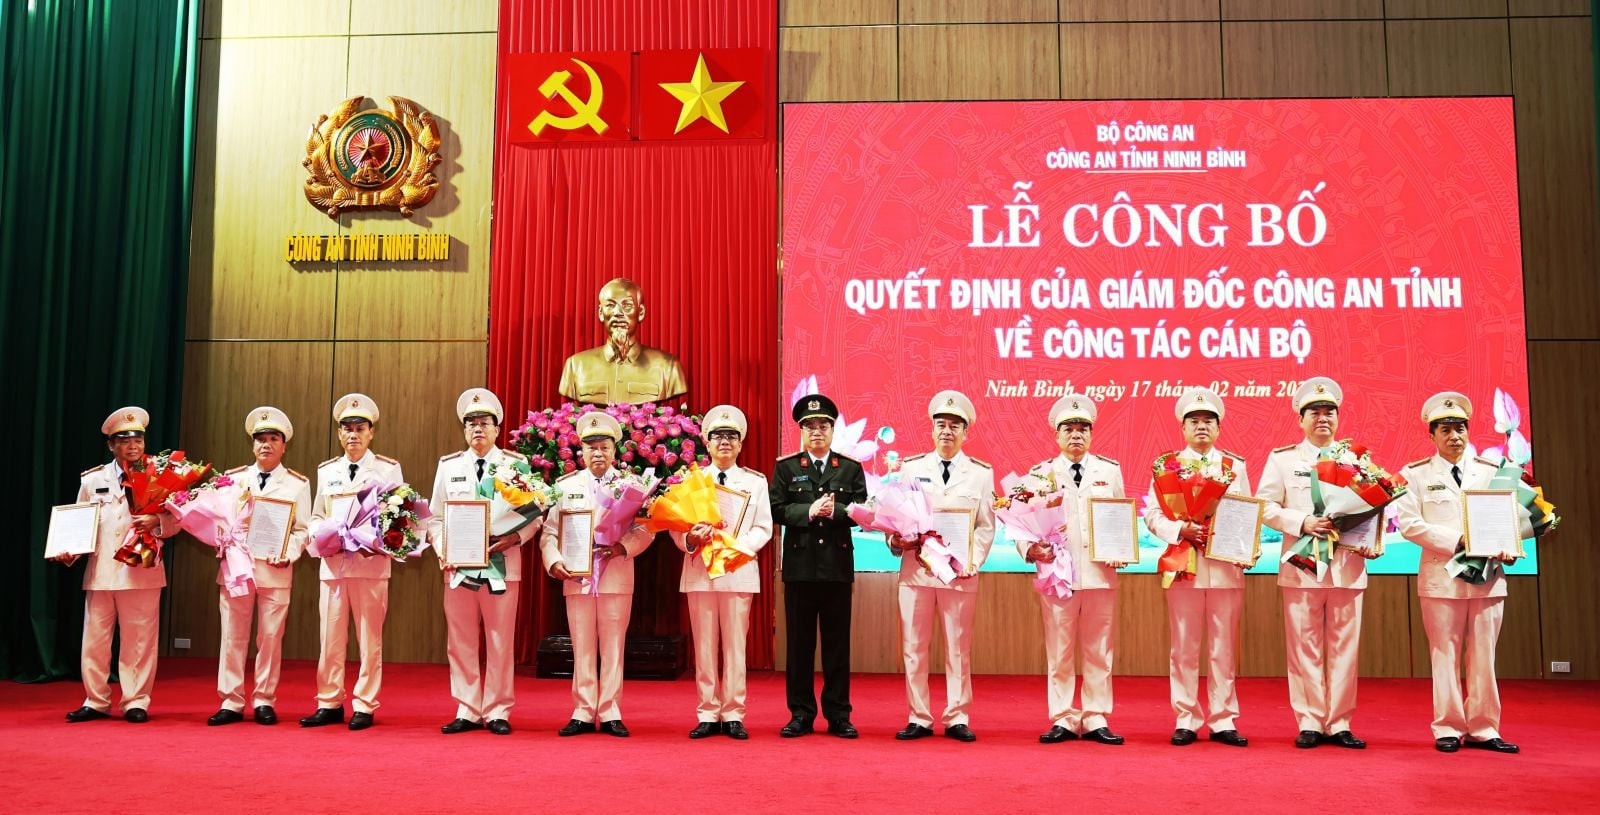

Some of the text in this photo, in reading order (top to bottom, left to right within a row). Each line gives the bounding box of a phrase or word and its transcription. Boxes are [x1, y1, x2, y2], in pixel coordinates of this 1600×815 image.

[1096, 120, 1195, 145] BỘ CÔNG AN
[1046, 145, 1246, 168] CÔNG AN TỈNH NINH BÌNH
[967, 181, 1327, 248] LỄ CÔNG BỐ
[286, 230, 321, 262] CÔNG
[325, 235, 345, 262] AN
[382, 234, 414, 261] NINH
[844, 266, 1462, 317] QUYẾT ĐỊNH CỦA GIÁM ĐỐC CÔNG AN TỈNH
[995, 315, 1312, 365] VỀ CÔNG TÁC CÁN BỘ
[985, 379, 1028, 398] Ninh
[1085, 379, 1126, 401] ngày
[1130, 380, 1152, 398] 17
[1155, 379, 1202, 397] thán
[1209, 380, 1230, 397] 02
[1233, 379, 1271, 398] năm
